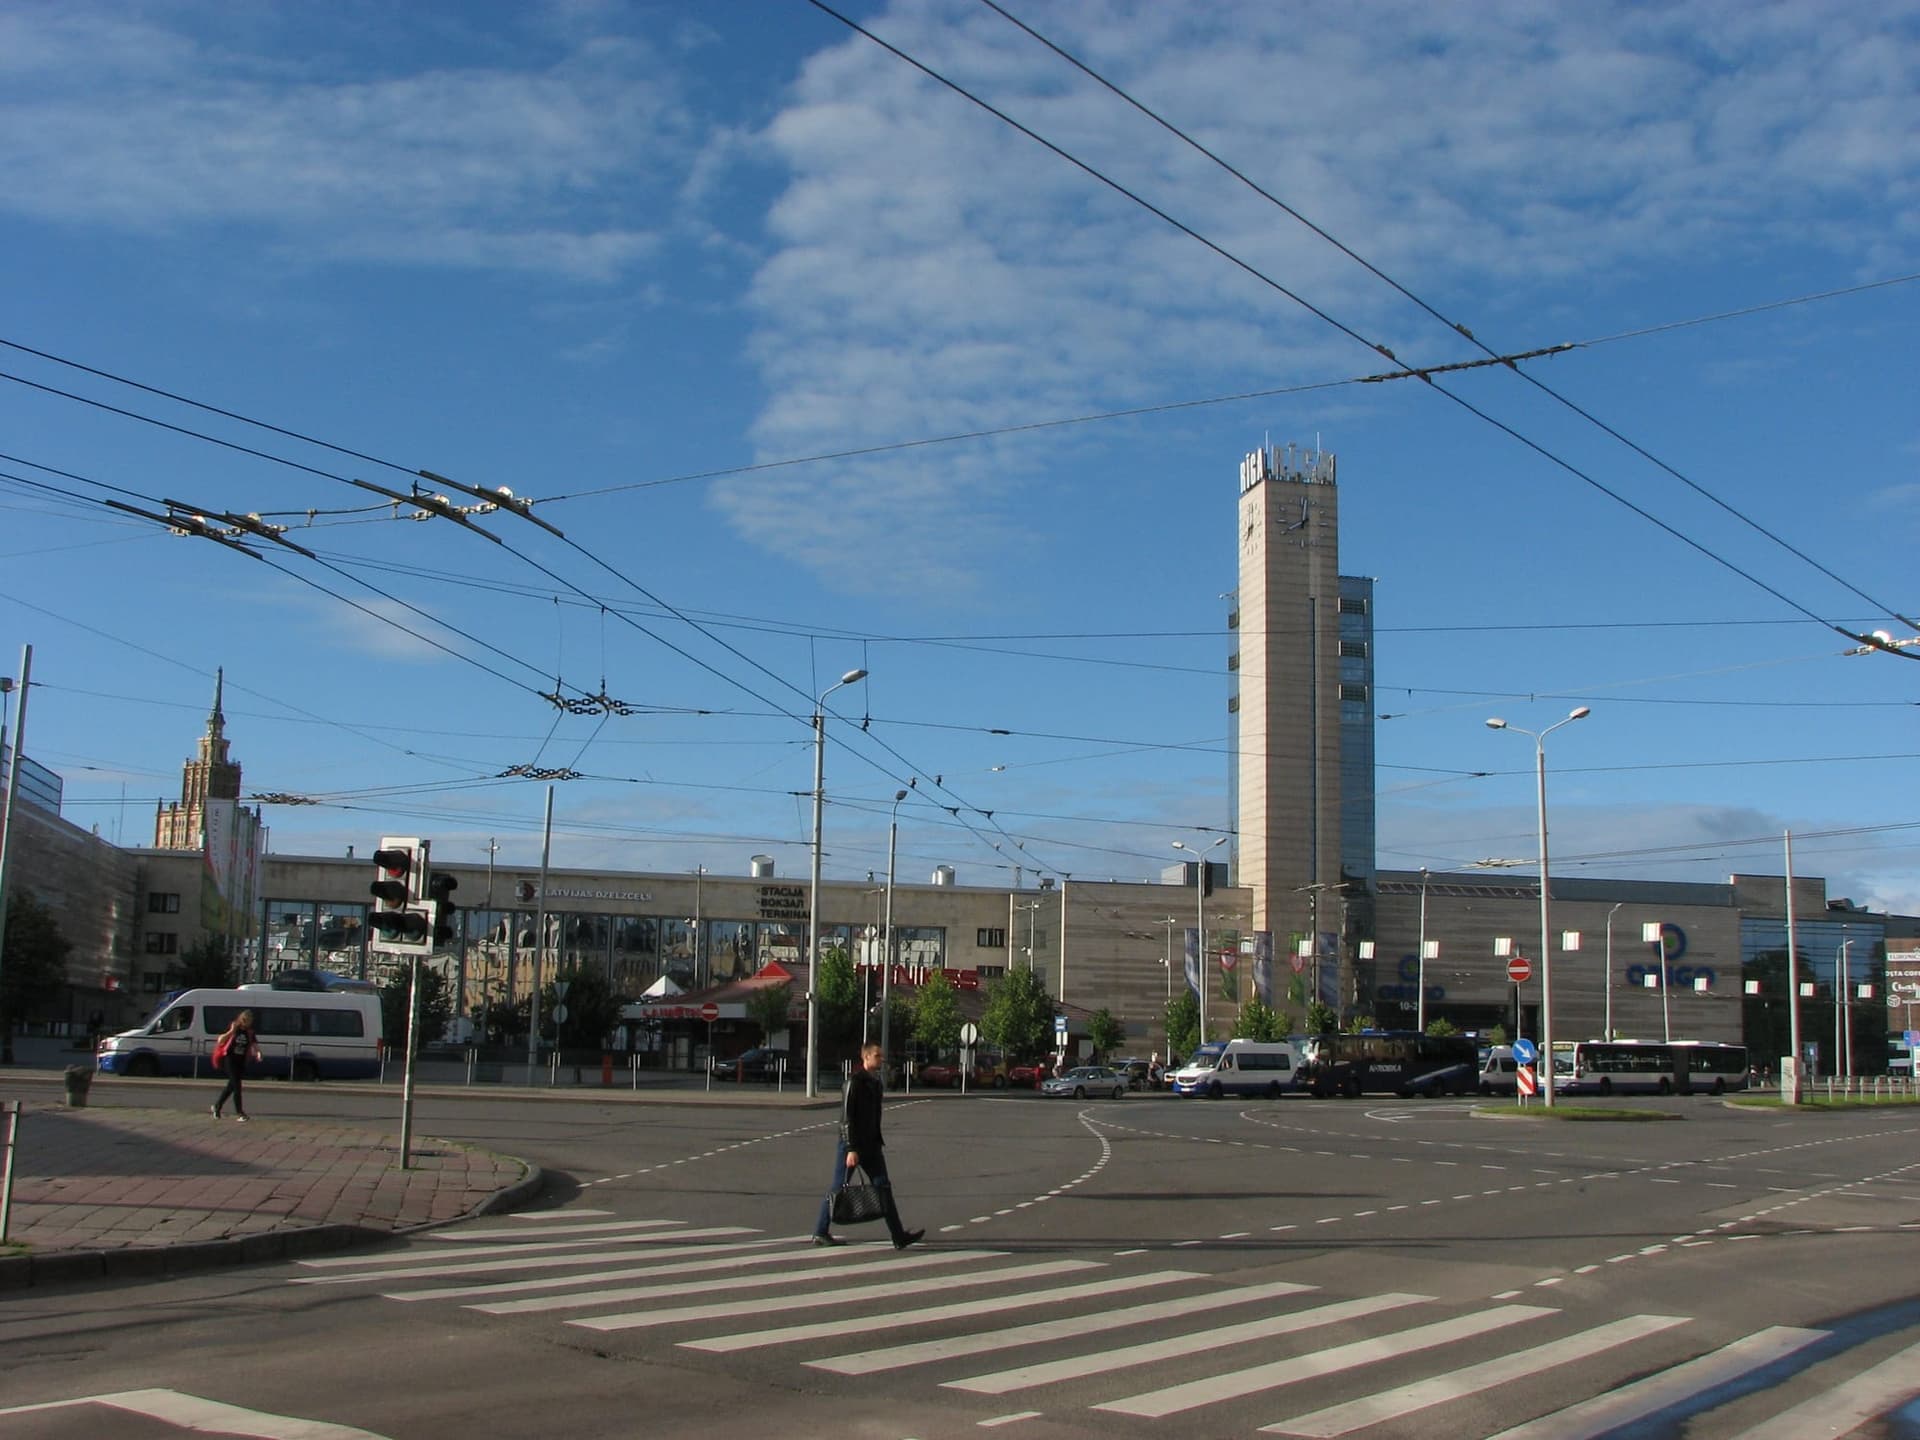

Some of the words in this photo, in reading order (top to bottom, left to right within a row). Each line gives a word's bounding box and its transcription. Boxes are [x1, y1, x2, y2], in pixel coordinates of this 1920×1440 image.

[545, 887, 592, 898] LATVIJAS
[761, 886, 804, 896] STACIJA
[761, 898, 804, 908] ВОКЗАЛ
